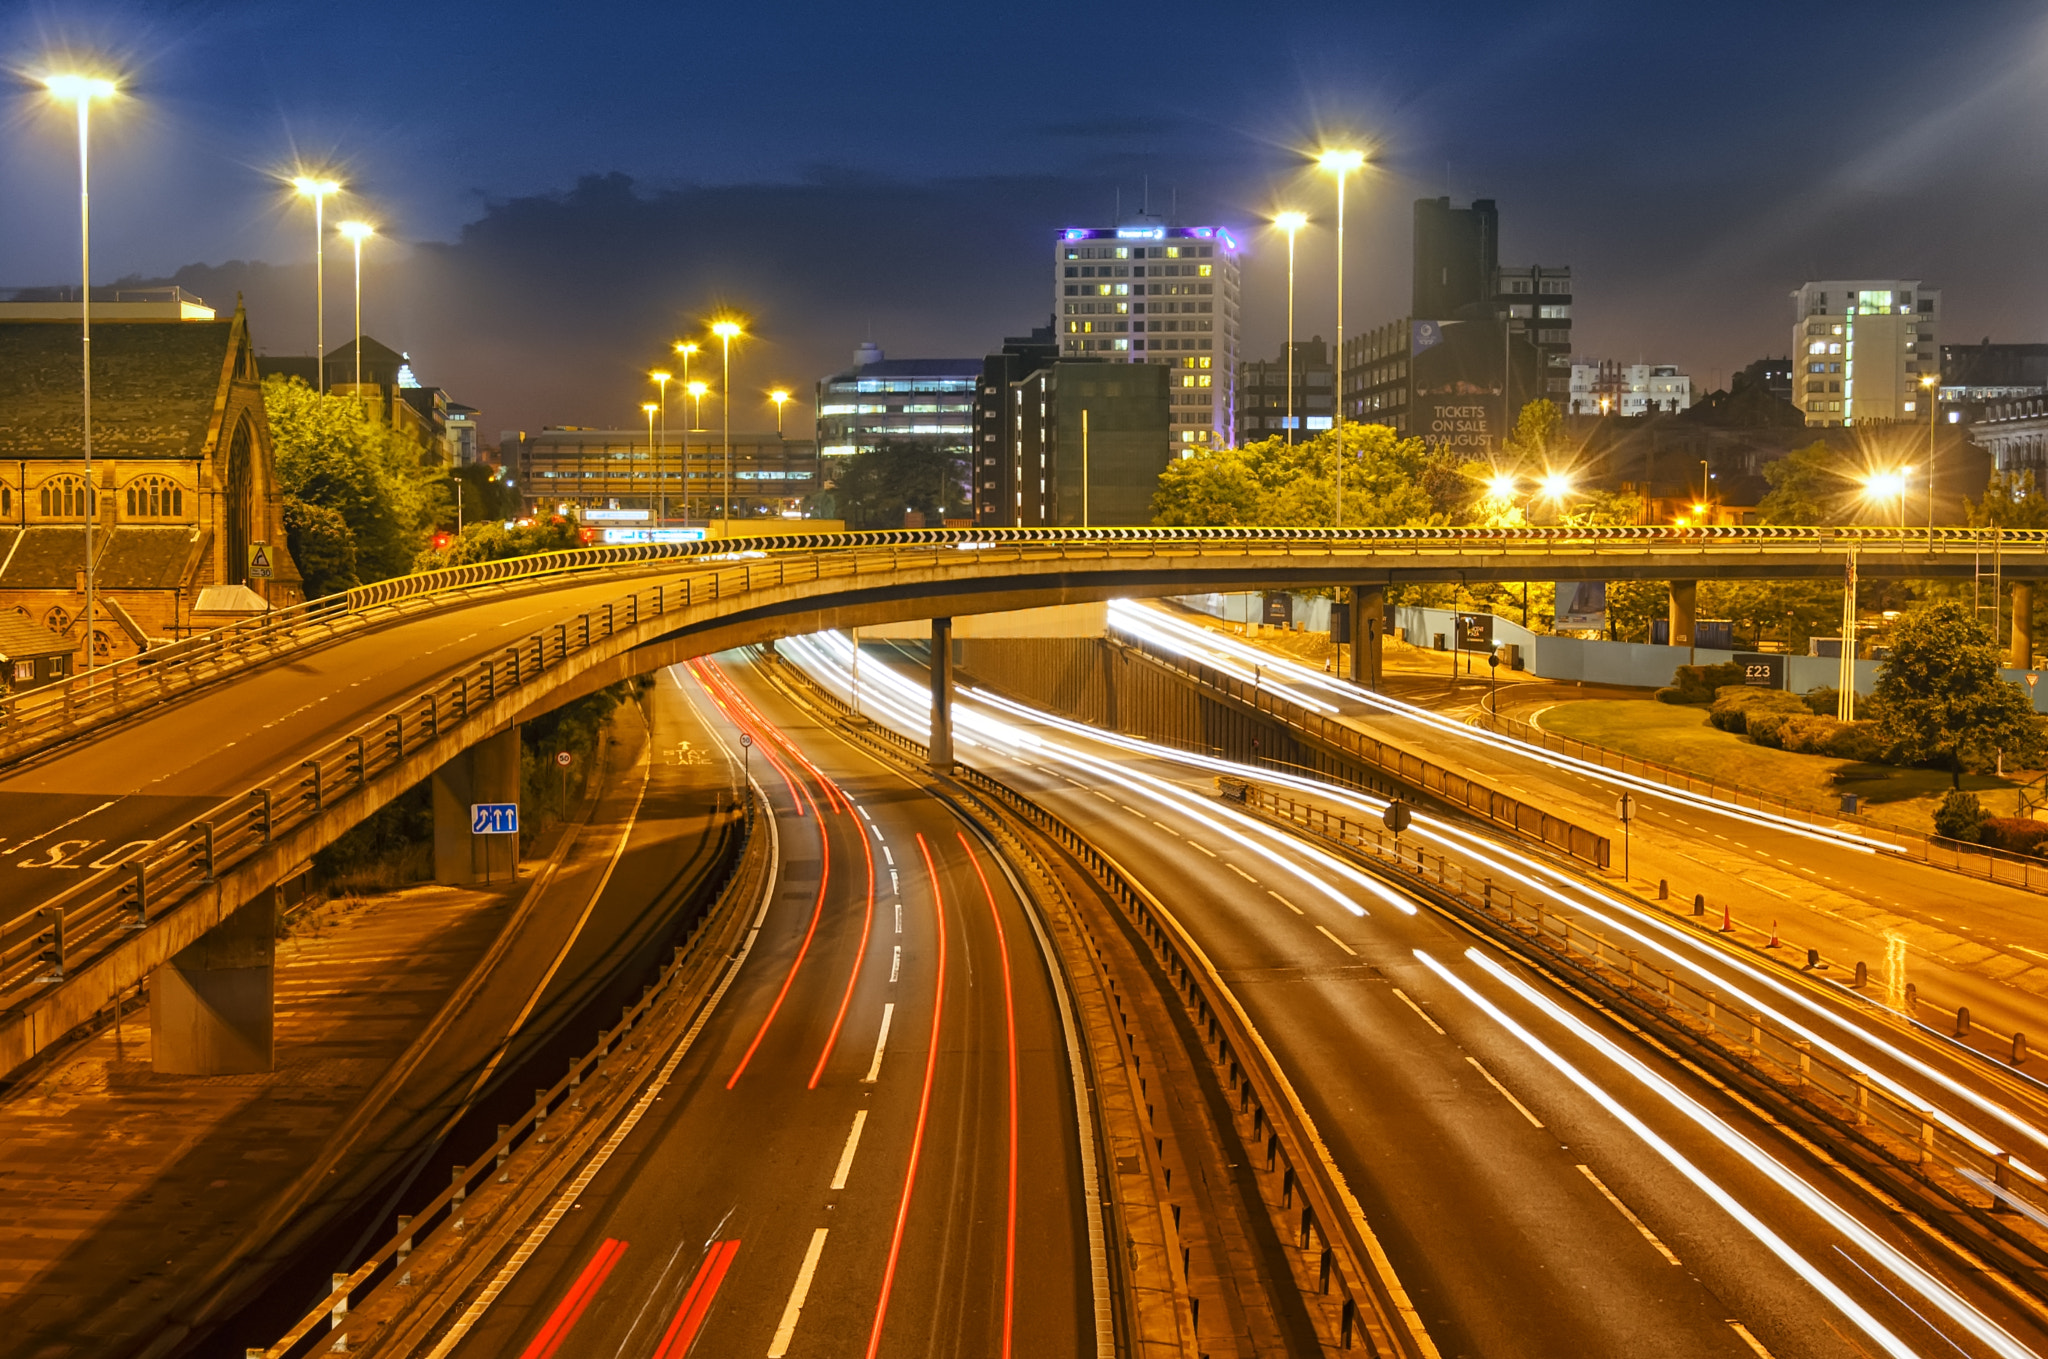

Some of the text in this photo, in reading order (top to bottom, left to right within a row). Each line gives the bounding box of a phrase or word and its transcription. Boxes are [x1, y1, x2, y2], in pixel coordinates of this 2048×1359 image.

[1434, 406, 1485, 418] TICKETS
[1432, 420, 1487, 432] ON SALE
[1425, 434, 1494, 446] 19 AUGUST
[260, 569, 271, 577] 30
[1746, 665, 1771, 678] £23
[16, 839, 188, 869] SLO
